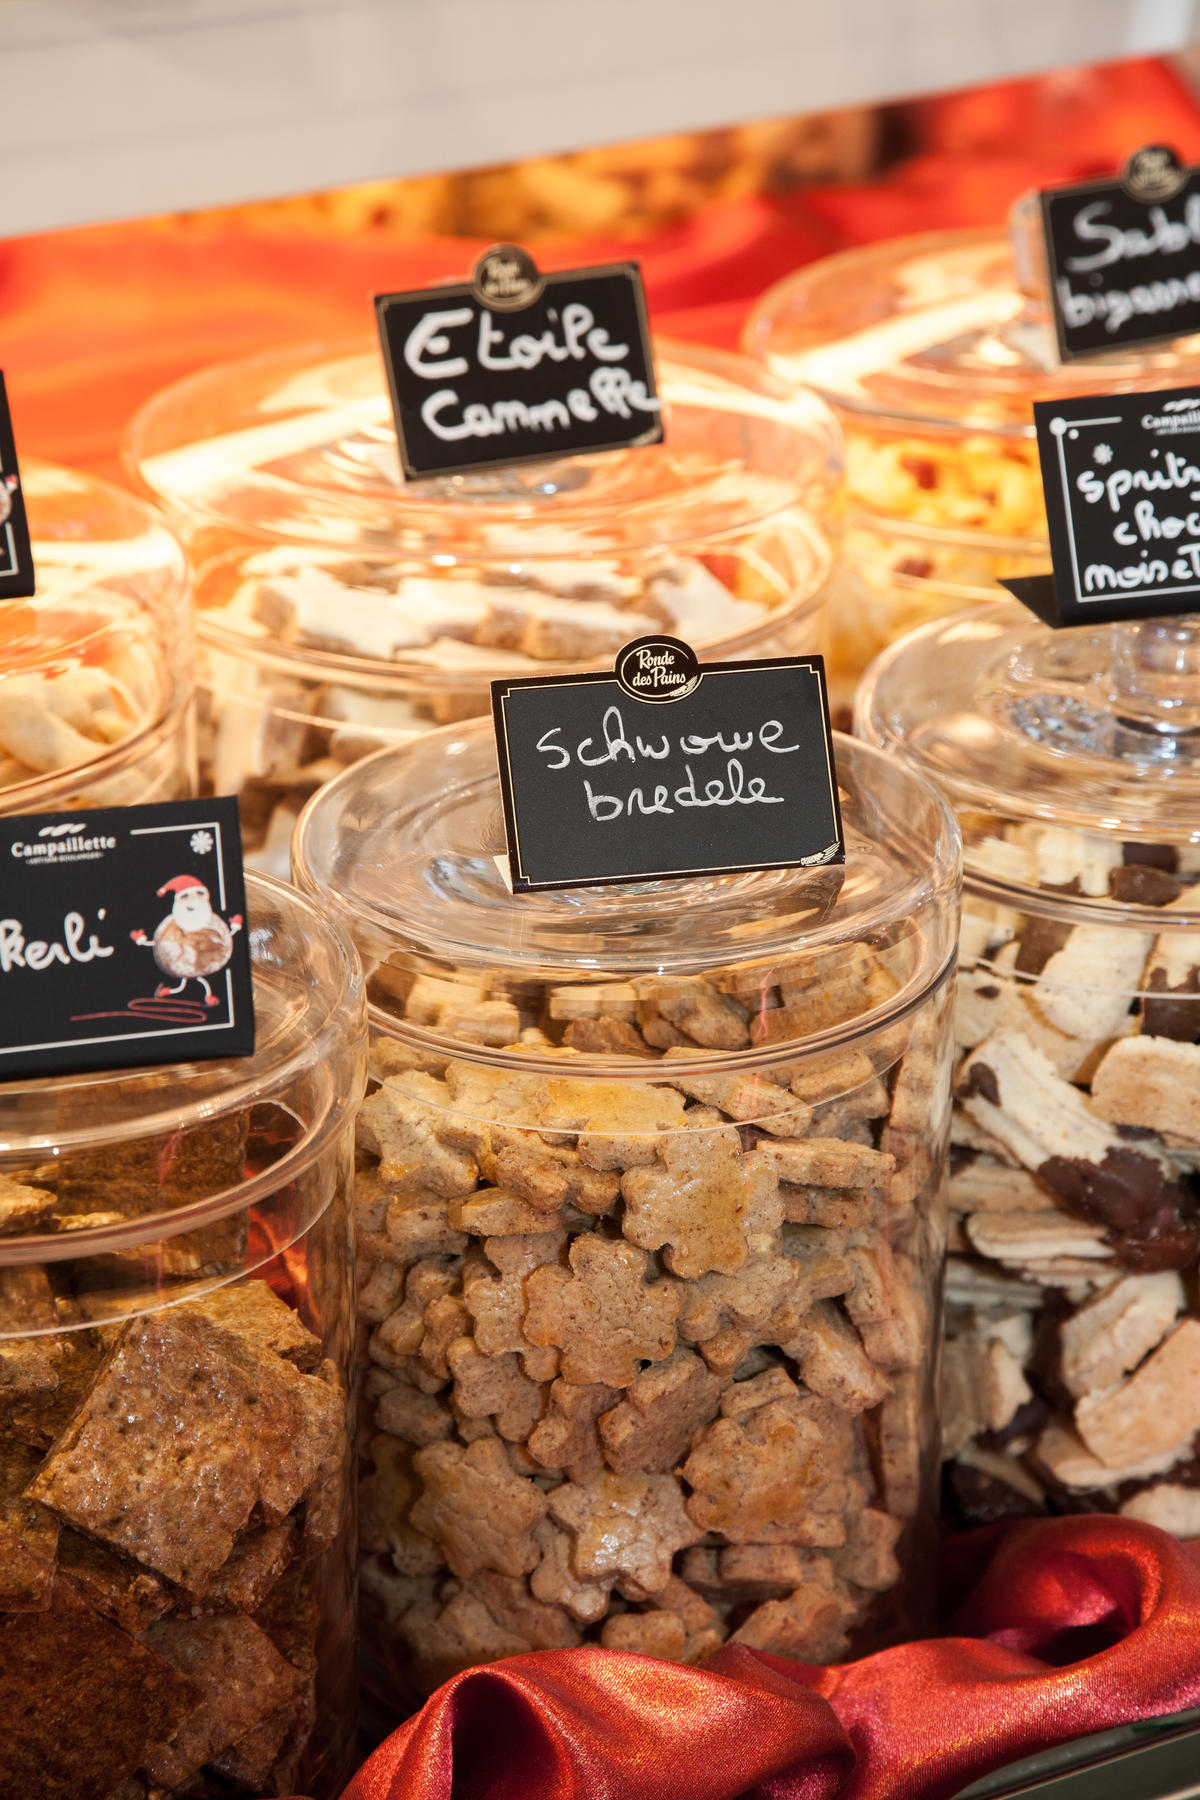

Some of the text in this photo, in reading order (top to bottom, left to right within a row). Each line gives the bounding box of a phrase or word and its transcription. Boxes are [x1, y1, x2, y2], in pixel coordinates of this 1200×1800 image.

[636, 649, 675, 669] Ronde
[632, 666, 686, 687] des Pains
[11, 836, 117, 858] Campaillette
